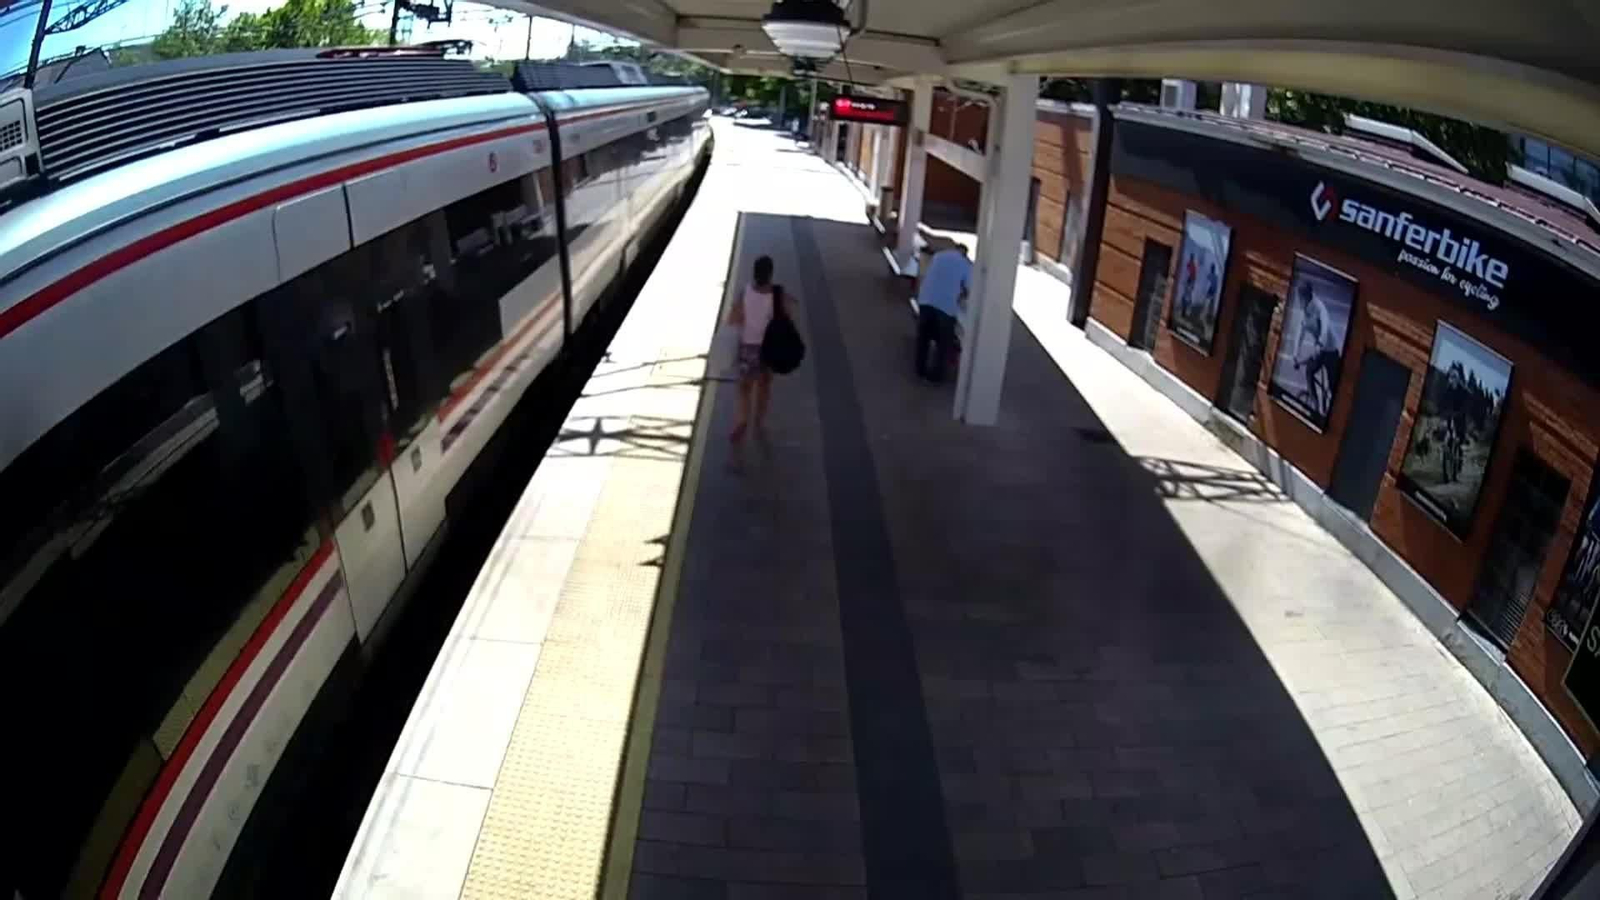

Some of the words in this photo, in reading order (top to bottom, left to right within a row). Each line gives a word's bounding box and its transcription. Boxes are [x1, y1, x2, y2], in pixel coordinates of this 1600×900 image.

[1339, 198, 1509, 288] sanferbike
[1398, 249, 1439, 276] passion
[1440, 265, 1458, 285] for
[1459, 278, 1501, 310] cycling
